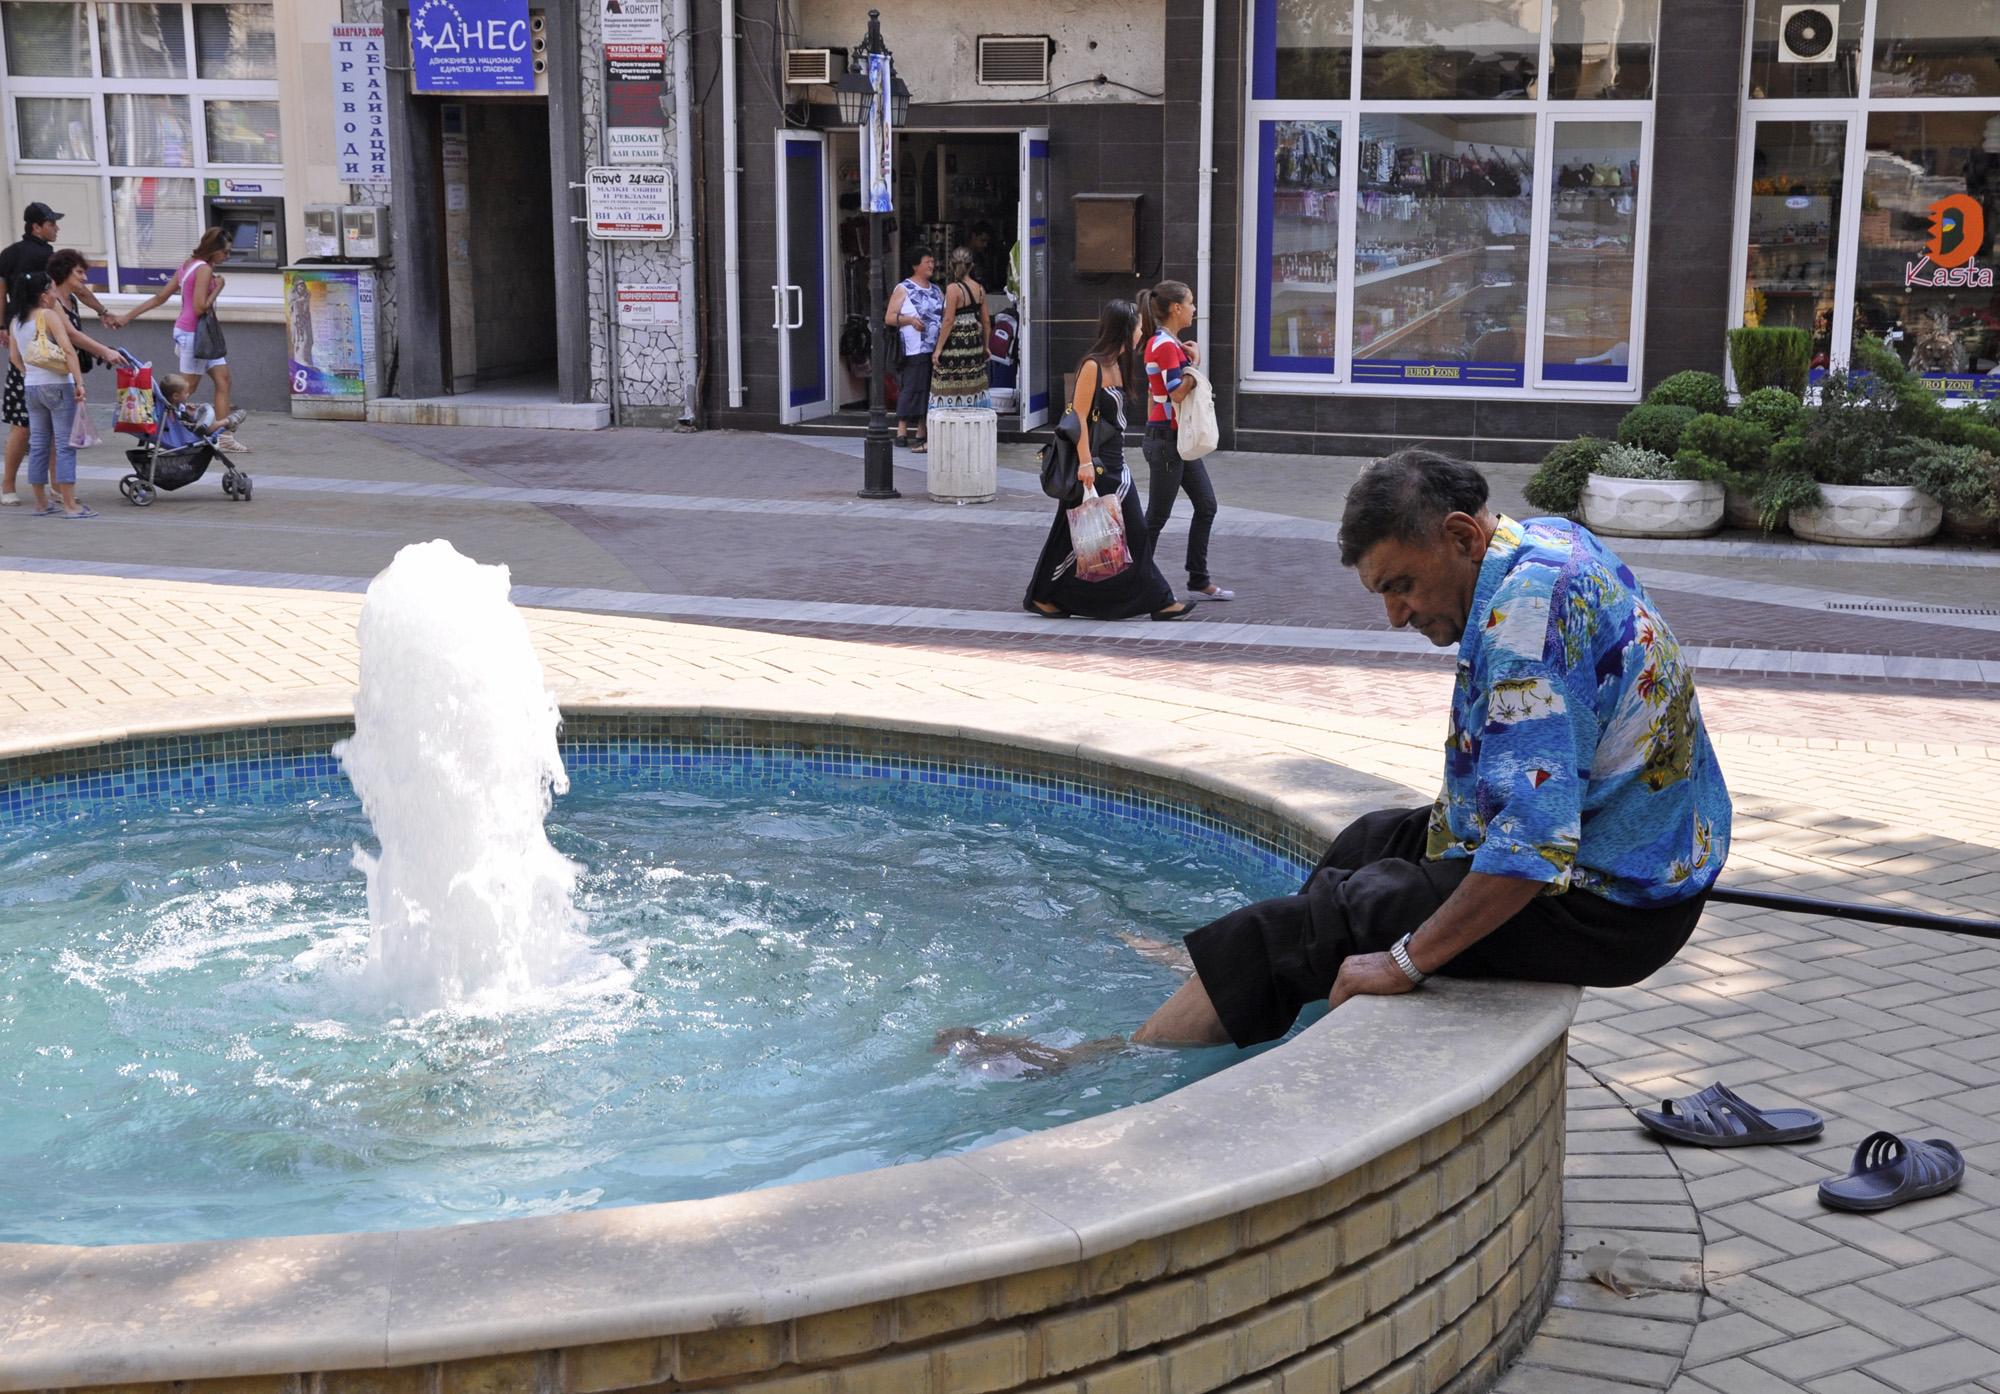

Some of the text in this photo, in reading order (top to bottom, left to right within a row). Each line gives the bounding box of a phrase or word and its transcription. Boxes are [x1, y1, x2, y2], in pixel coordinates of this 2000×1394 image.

[625, 4, 659, 14] КОНСУЛТ
[433, 20, 526, 53] ДНЕС
[339, 41, 359, 173] ПРЕВОДИ
[366, 41, 386, 173] ЛЕГАЛИЗАЦИЯ
[610, 134, 659, 143] АДВОКАТ
[628, 174, 641, 184] 24
[1905, 256, 1993, 287] Kasta
[293, 370, 307, 392] 8
